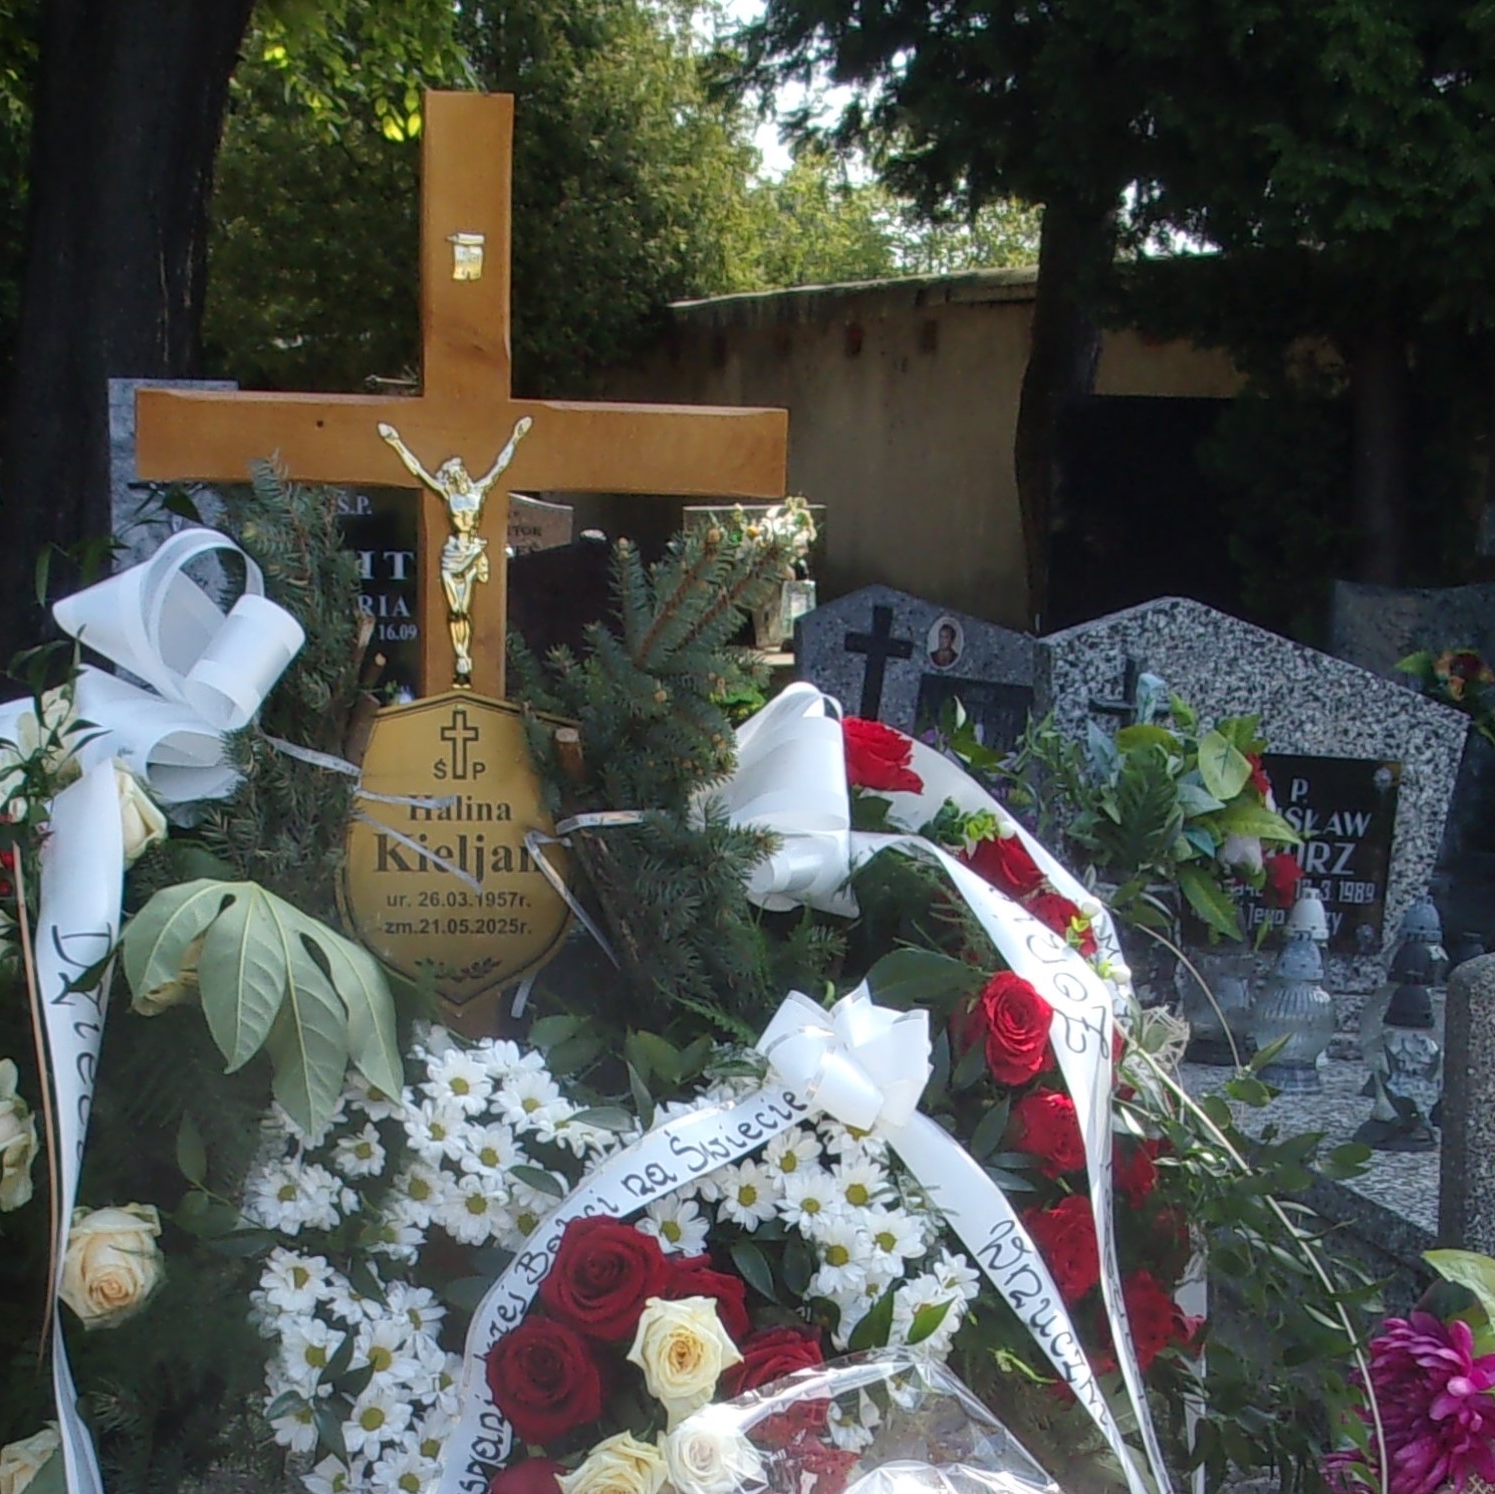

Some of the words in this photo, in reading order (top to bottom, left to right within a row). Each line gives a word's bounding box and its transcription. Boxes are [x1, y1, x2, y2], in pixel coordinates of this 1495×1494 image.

[408, 794, 512, 822] Halina
[386, 894, 412, 908] ur.
[1338, 880, 1377, 904] 1989
[621, 1162, 678, 1197] na
